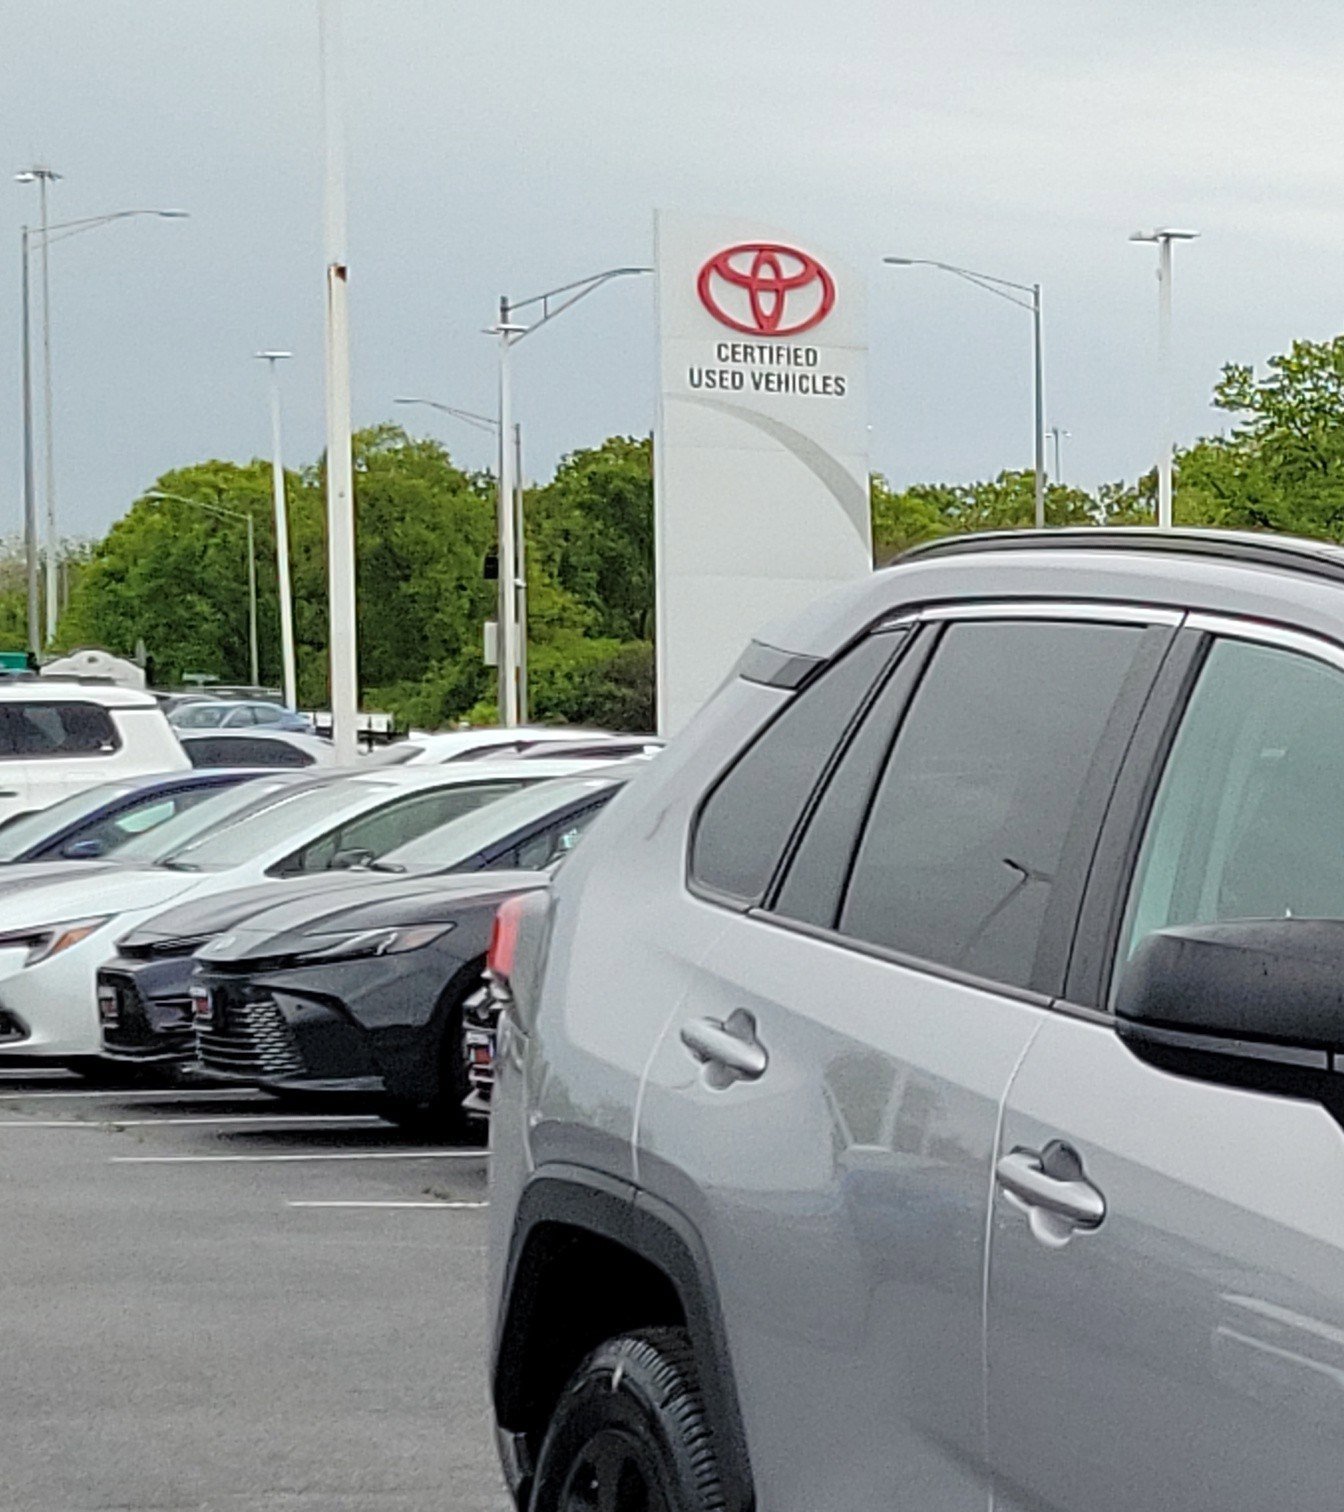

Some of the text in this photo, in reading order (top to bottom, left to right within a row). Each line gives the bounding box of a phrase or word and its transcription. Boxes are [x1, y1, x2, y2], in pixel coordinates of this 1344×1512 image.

[717, 343, 818, 367] CERTIFIED
[689, 367, 846, 396] USED VEHICLES
